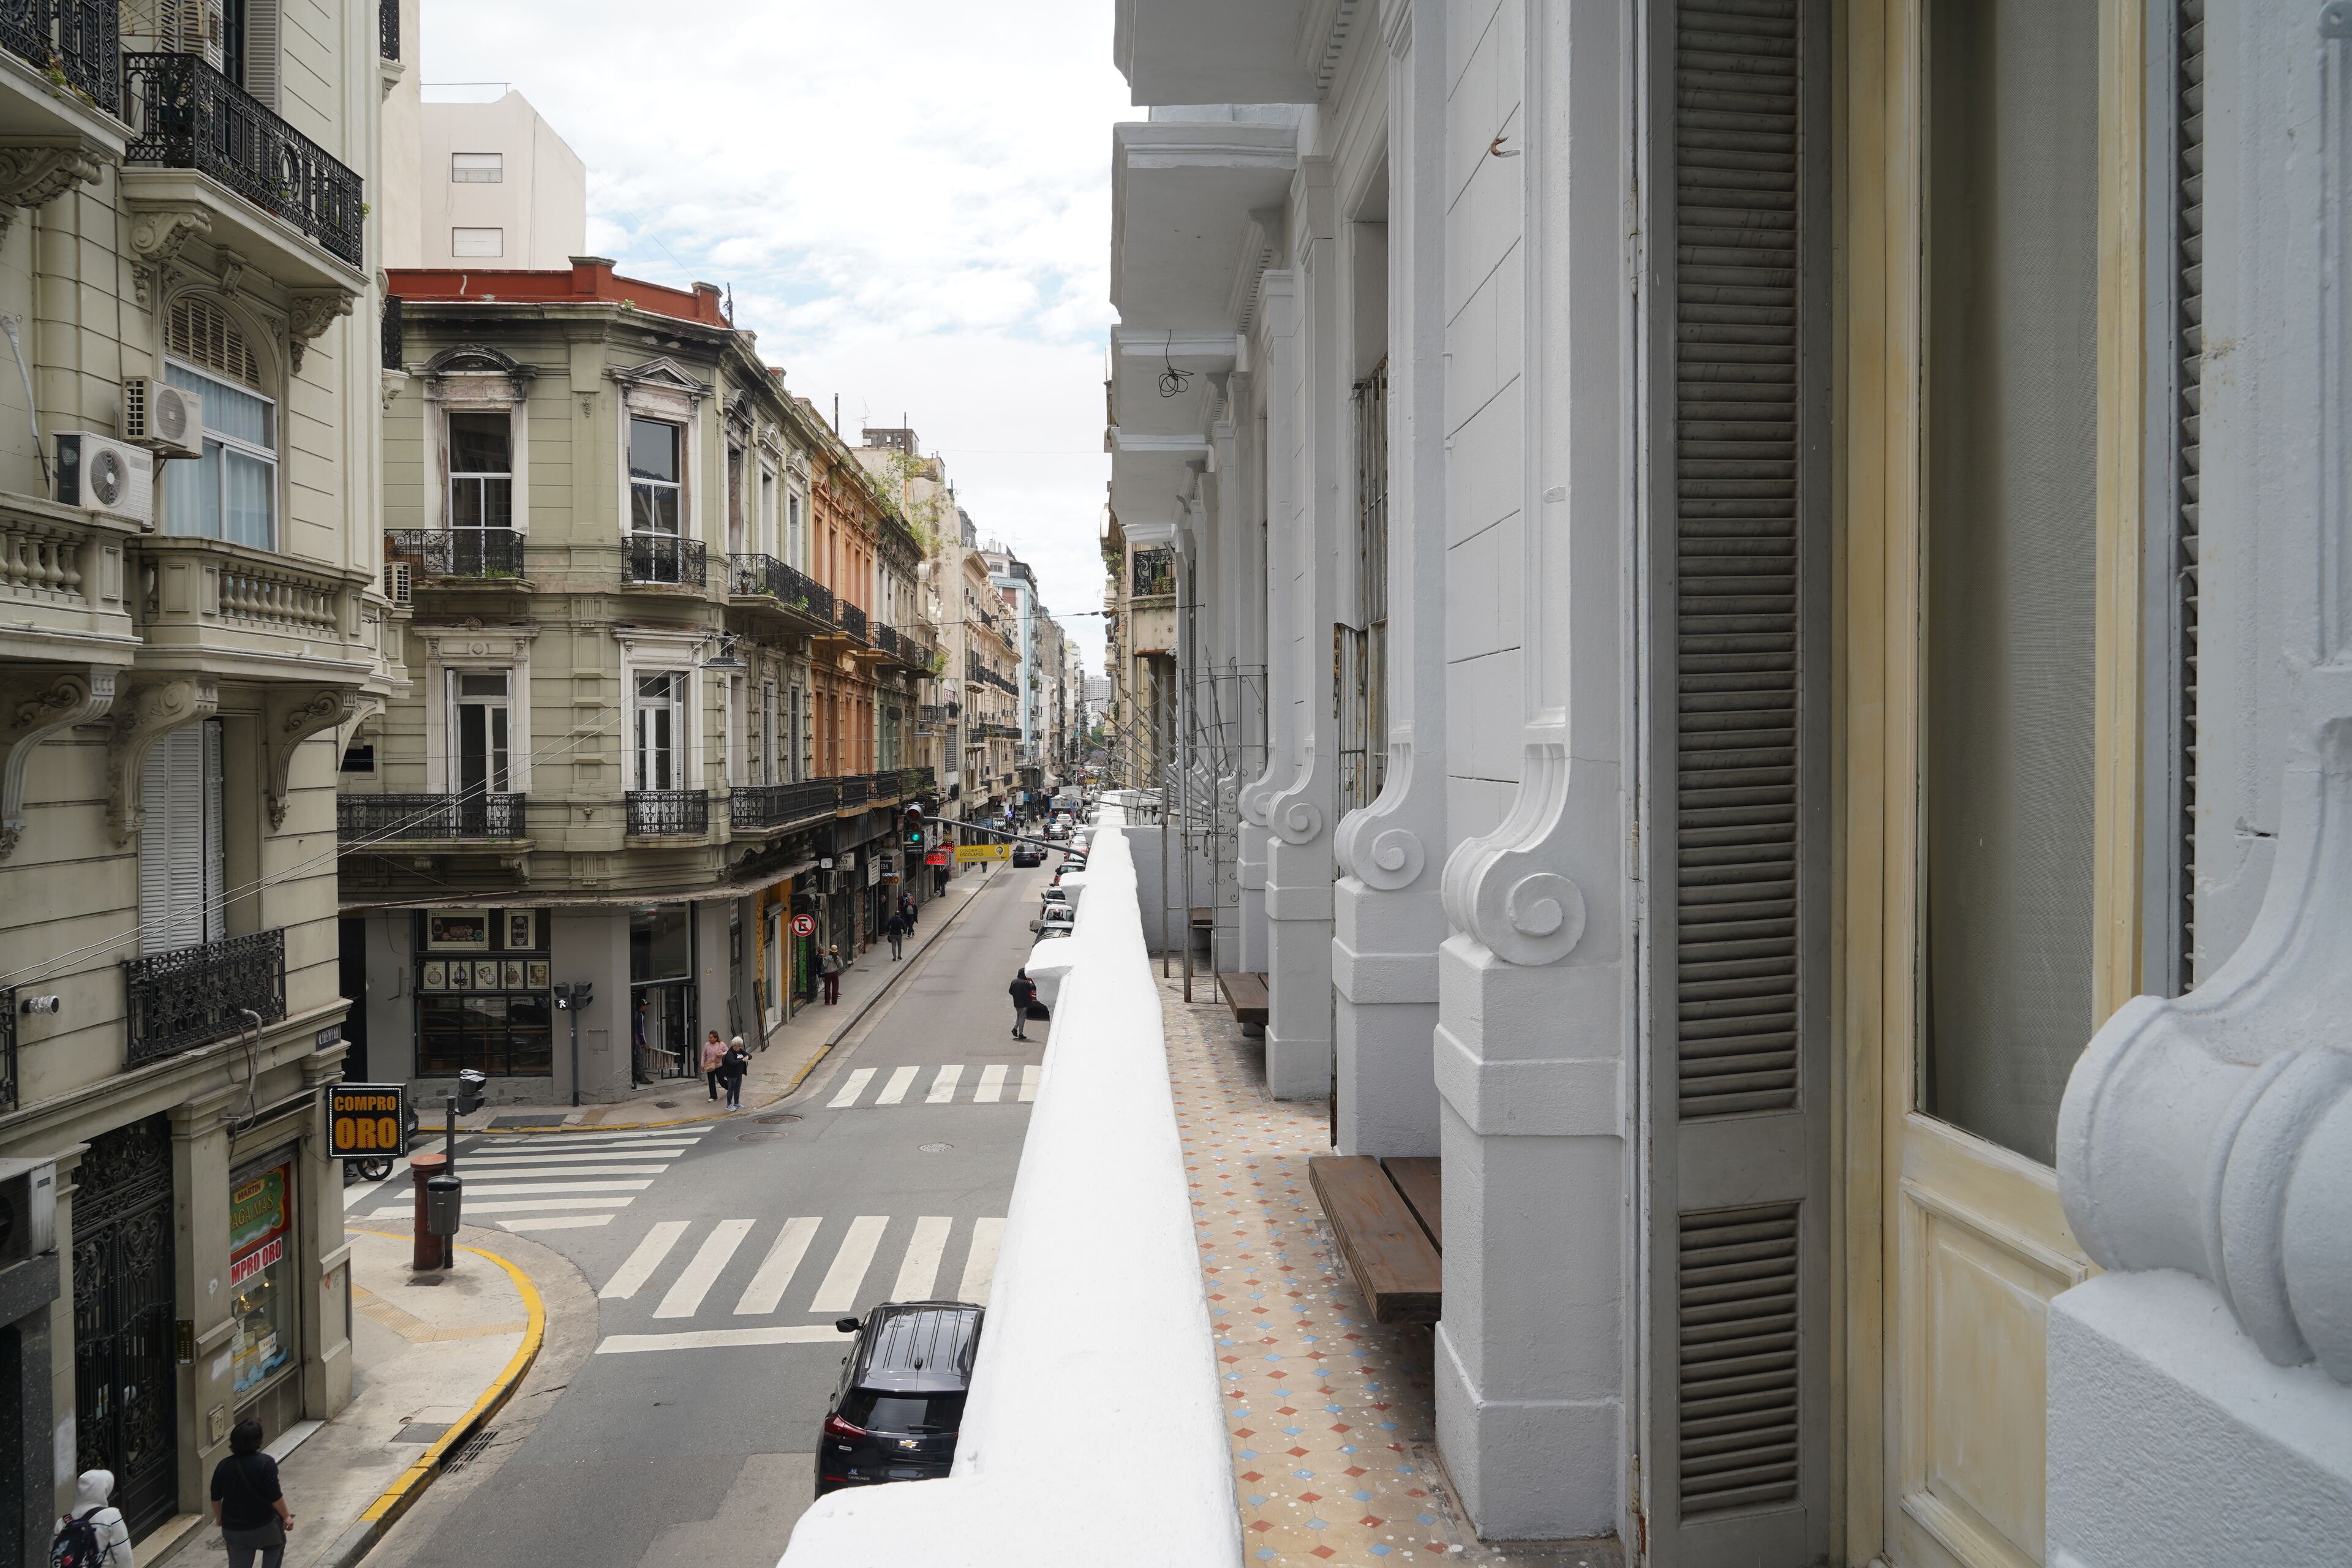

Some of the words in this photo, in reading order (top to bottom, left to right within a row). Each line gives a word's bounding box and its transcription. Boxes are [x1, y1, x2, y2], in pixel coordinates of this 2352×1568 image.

[334, 1096, 396, 1111] COMPRO
[334, 1117, 398, 1149] ORO
[238, 1183, 261, 1201] MARTIN
[254, 1193, 274, 1218] MAS
[262, 1238, 282, 1267] ORO
